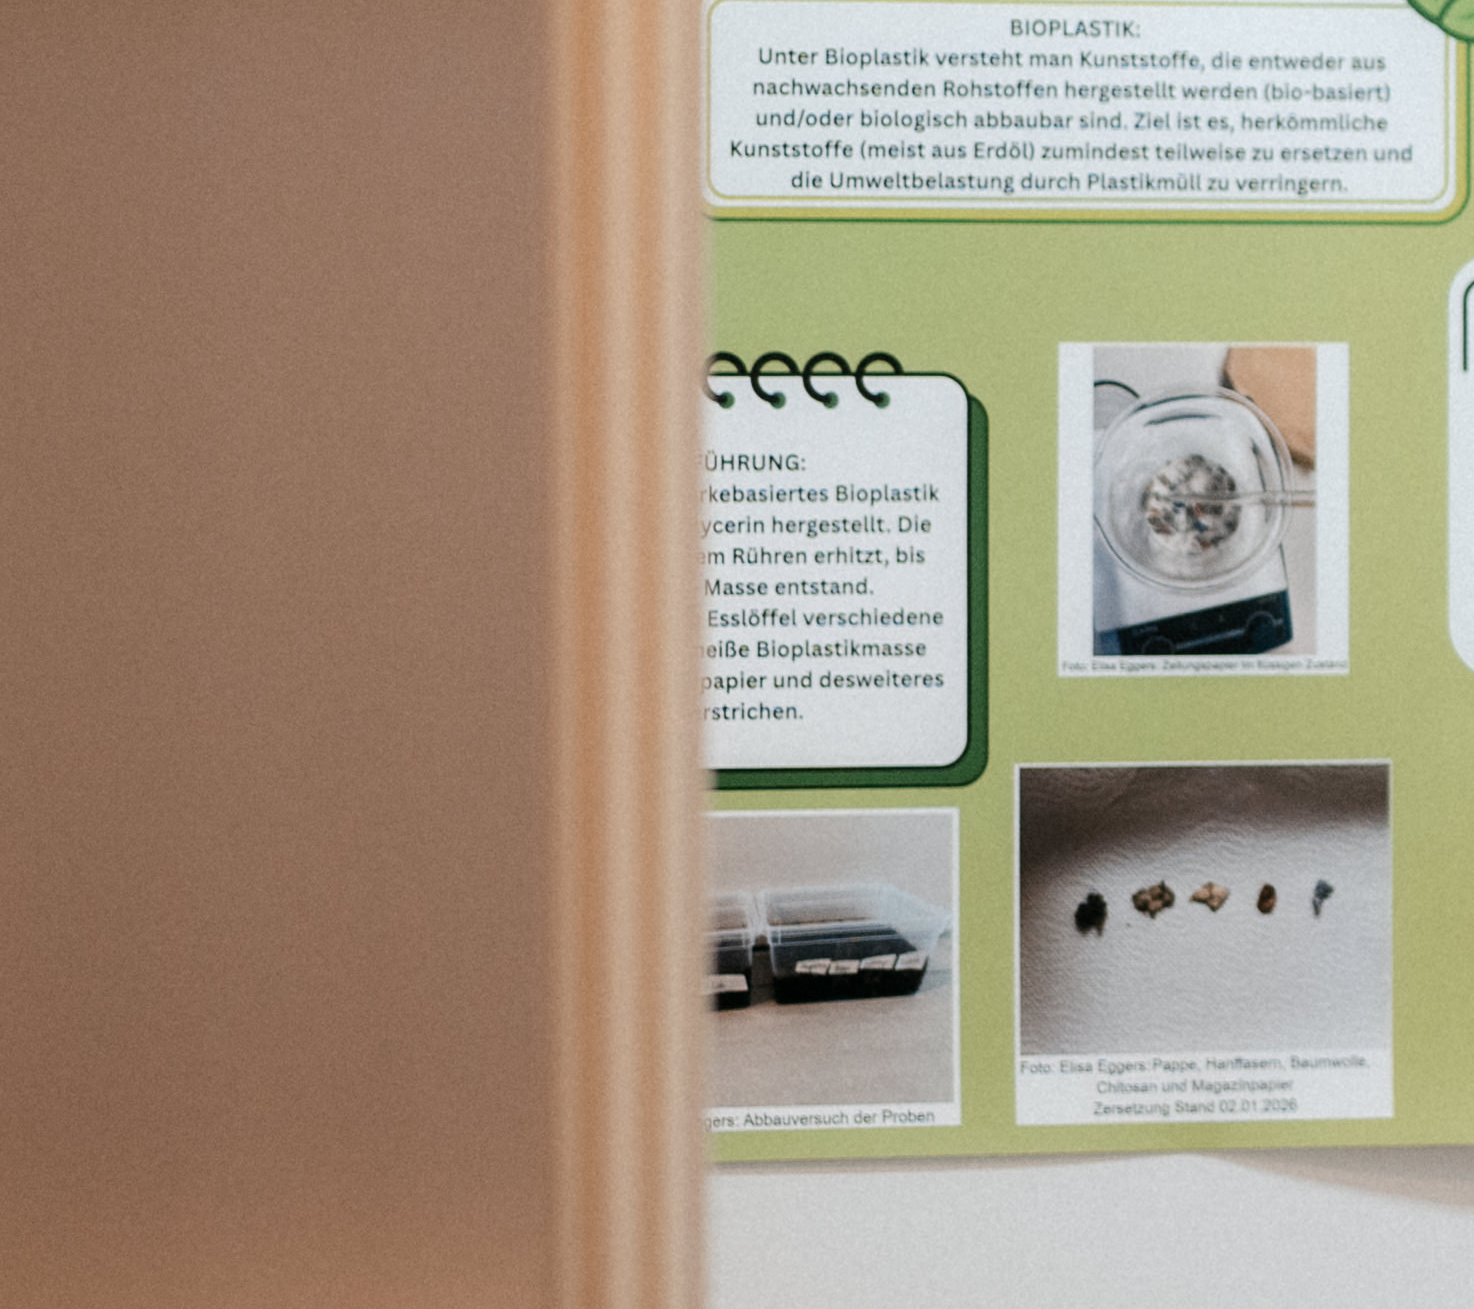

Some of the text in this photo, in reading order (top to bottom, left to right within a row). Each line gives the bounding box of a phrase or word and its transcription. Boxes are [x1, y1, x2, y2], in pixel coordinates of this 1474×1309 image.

[1010, 19, 1140, 38] BIOPLASTIK:
[758, 47, 1386, 71] Unter Bioplastik versteht man Kunststoffe, die entweder aus
[752, 78, 1391, 104] nachwachsenden Rohstoffen hergestellt werden (bio-basiert)
[755, 108, 1388, 133] und/oder biologisch abbaubar sind. Ziel ist es, herkömmliche
[730, 139, 1413, 162] Kunststoffe (meist aus Erdöl) zumindest teilweise zu ersetzen und
[790, 170, 1347, 200] die Umweltbelastung durch Plastikmüll zu verringern.
[732, 547, 807, 565] Rühren
[813, 547, 889, 566] erhitzt,
[895, 546, 926, 564] bis
[702, 578, 874, 597] Masse entstand.
[705, 608, 944, 628] Esslöffel verschiedene
